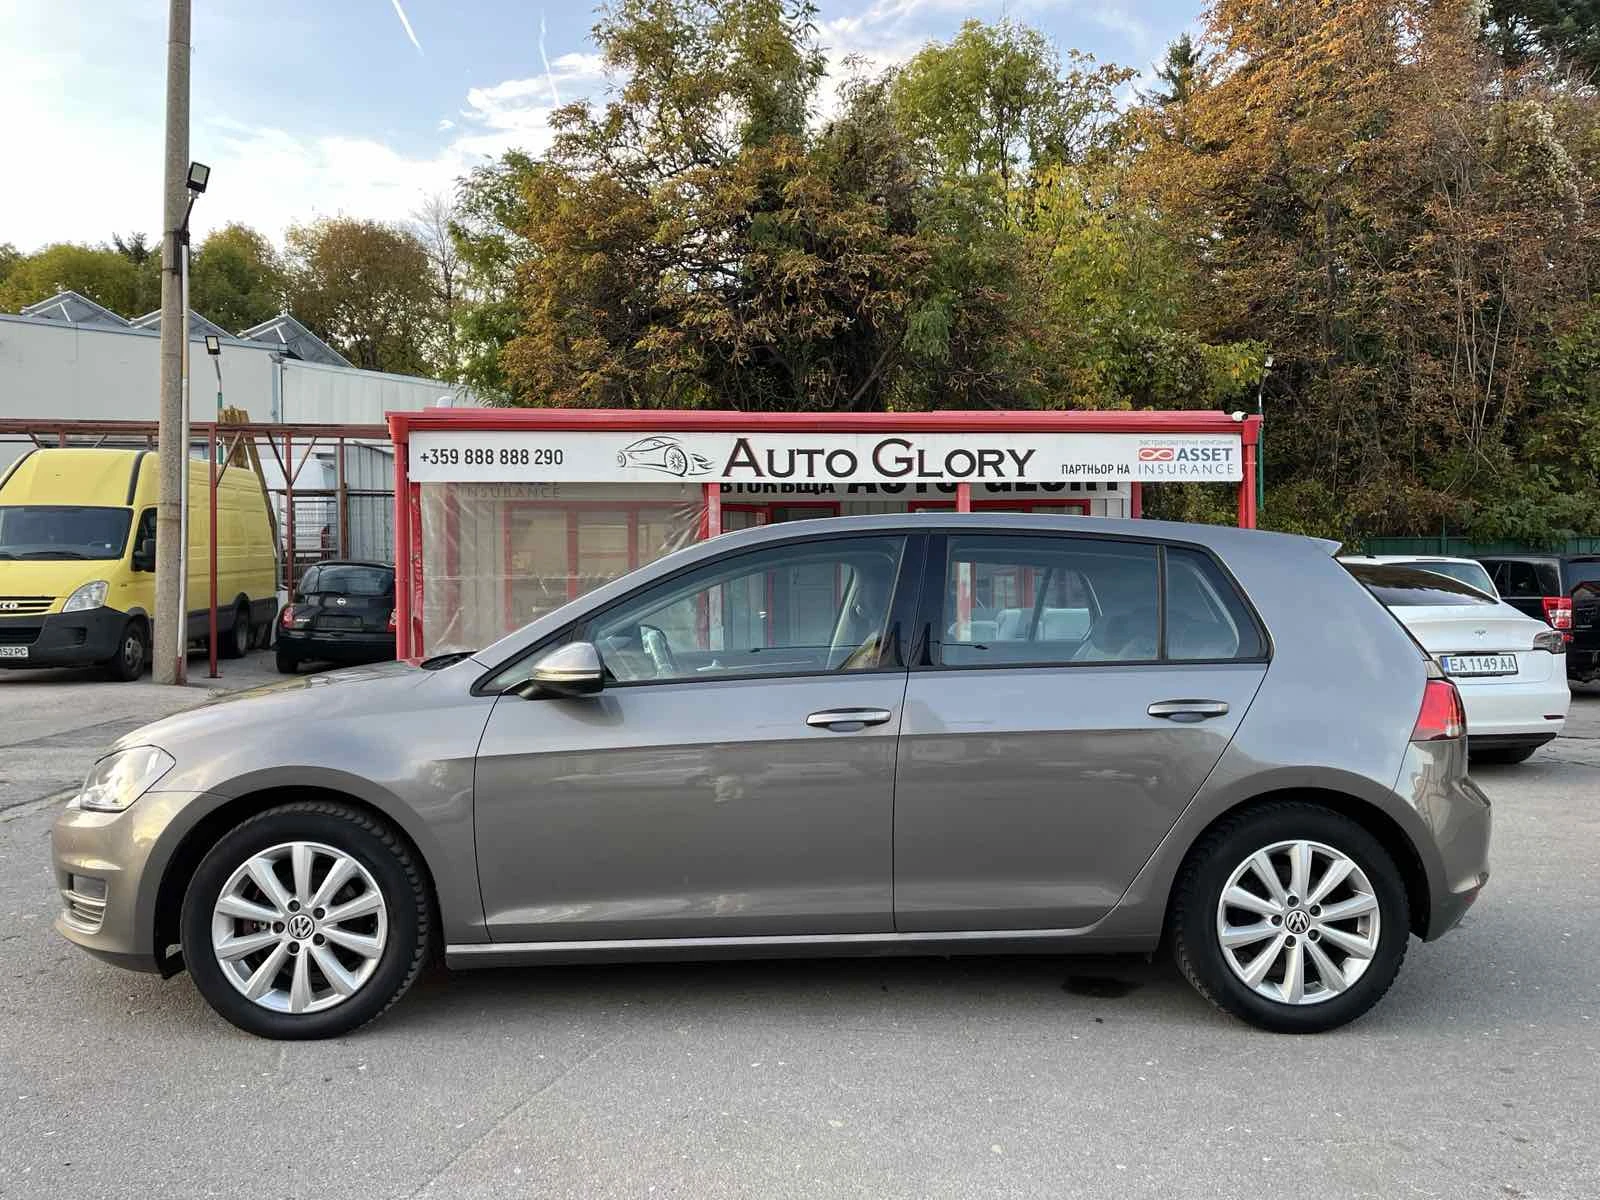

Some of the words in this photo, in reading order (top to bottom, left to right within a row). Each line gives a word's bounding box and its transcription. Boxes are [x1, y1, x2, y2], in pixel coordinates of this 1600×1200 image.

[420, 448, 459, 465] +359
[464, 448, 494, 465] 888
[500, 448, 529, 465] 888
[534, 448, 563, 465] 290
[721, 437, 858, 478] AUTO
[872, 437, 1037, 478] GLORY
[1176, 447, 1233, 462] ASSET
[1062, 463, 1114, 474] ПАРТНЬОР
[1117, 463, 1130, 474] НА
[1138, 463, 1233, 474] INSURANCE
[1450, 658, 1467, 671] EA
[1470, 657, 1497, 671] 1149
[1500, 656, 1515, 670] AA
